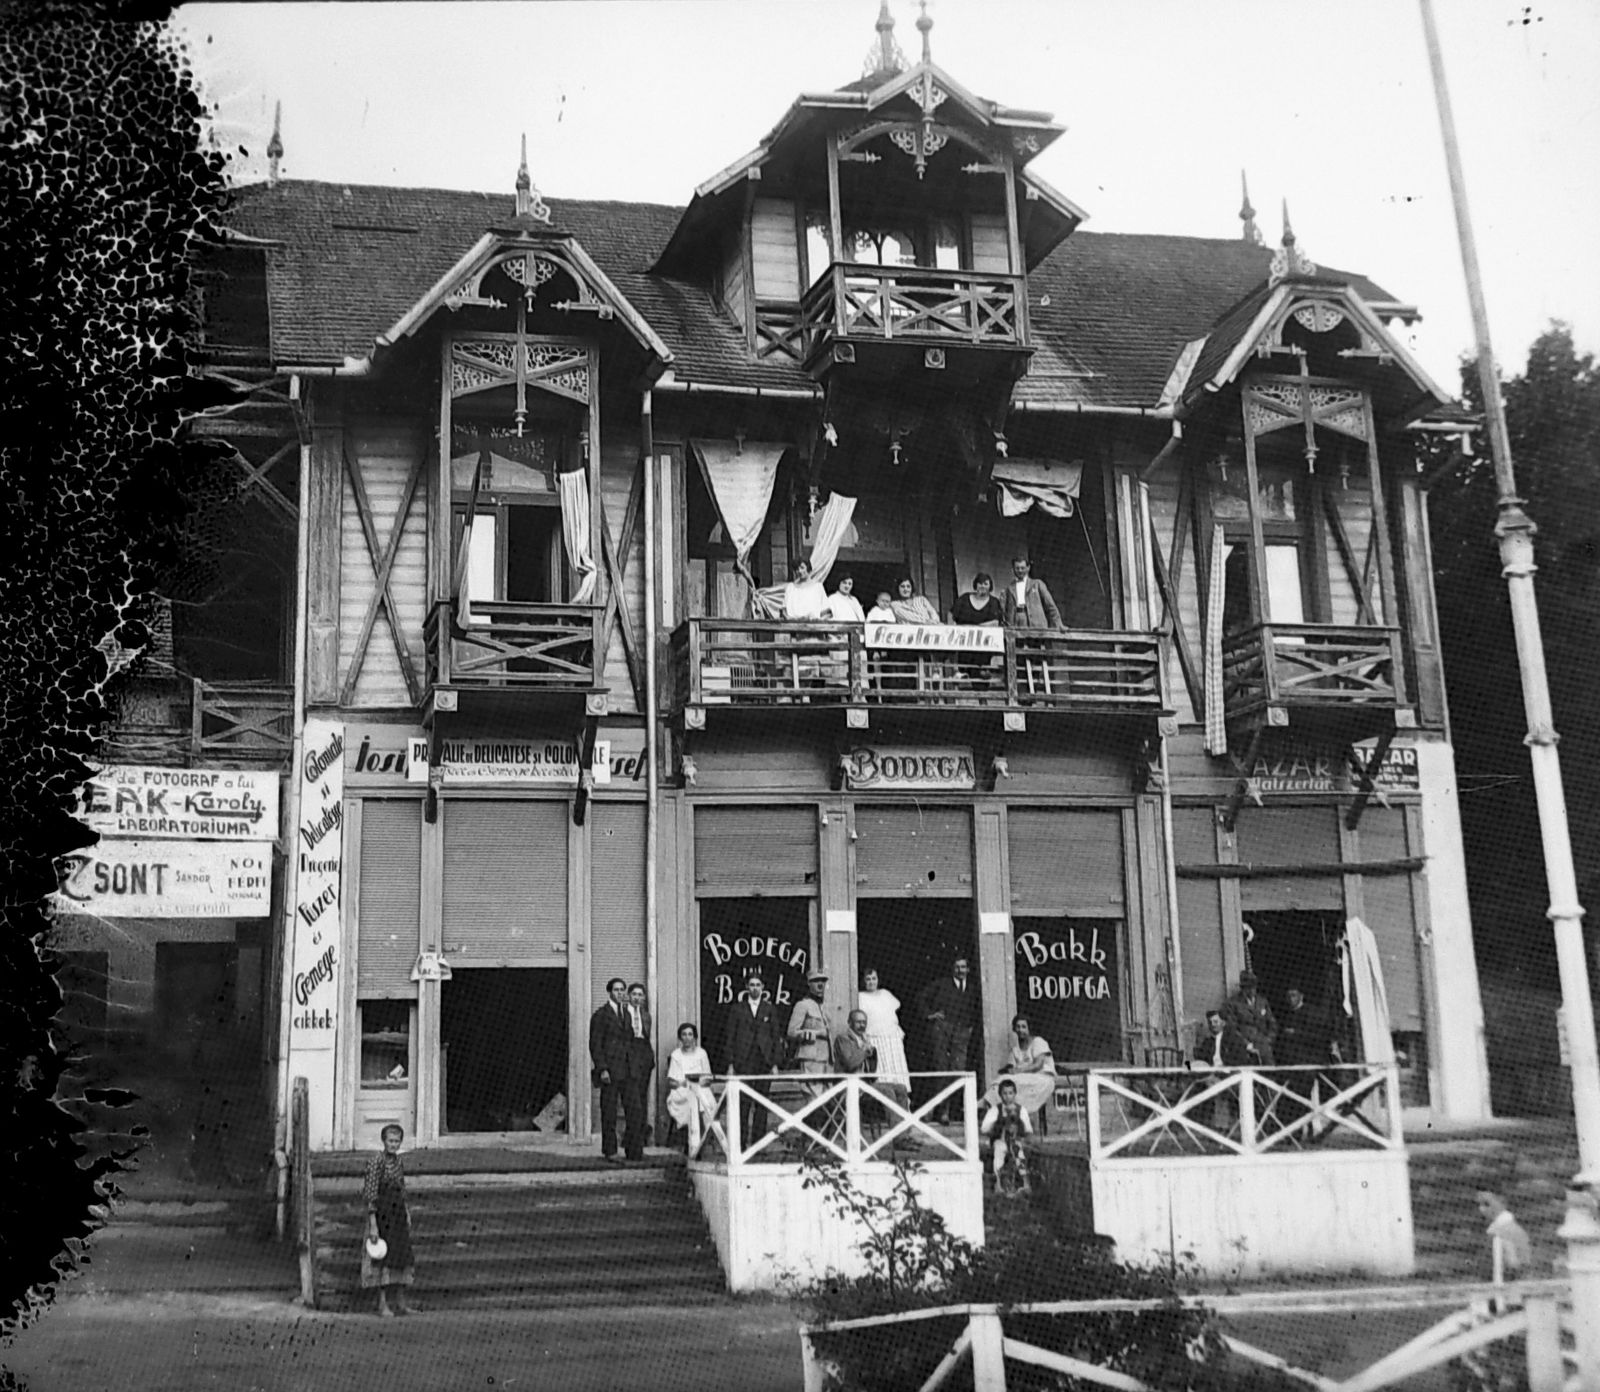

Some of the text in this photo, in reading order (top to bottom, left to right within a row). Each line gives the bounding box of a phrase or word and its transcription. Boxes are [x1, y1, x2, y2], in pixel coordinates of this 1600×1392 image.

[413, 742, 465, 763] PRALIE
[474, 743, 532, 764] DELICATESE
[849, 747, 975, 784] BODEGA
[143, 771, 220, 787] FOTOGRAF
[237, 774, 254, 789] lui
[703, 932, 807, 974] BODEGA
[1015, 927, 1108, 971] Bakk
